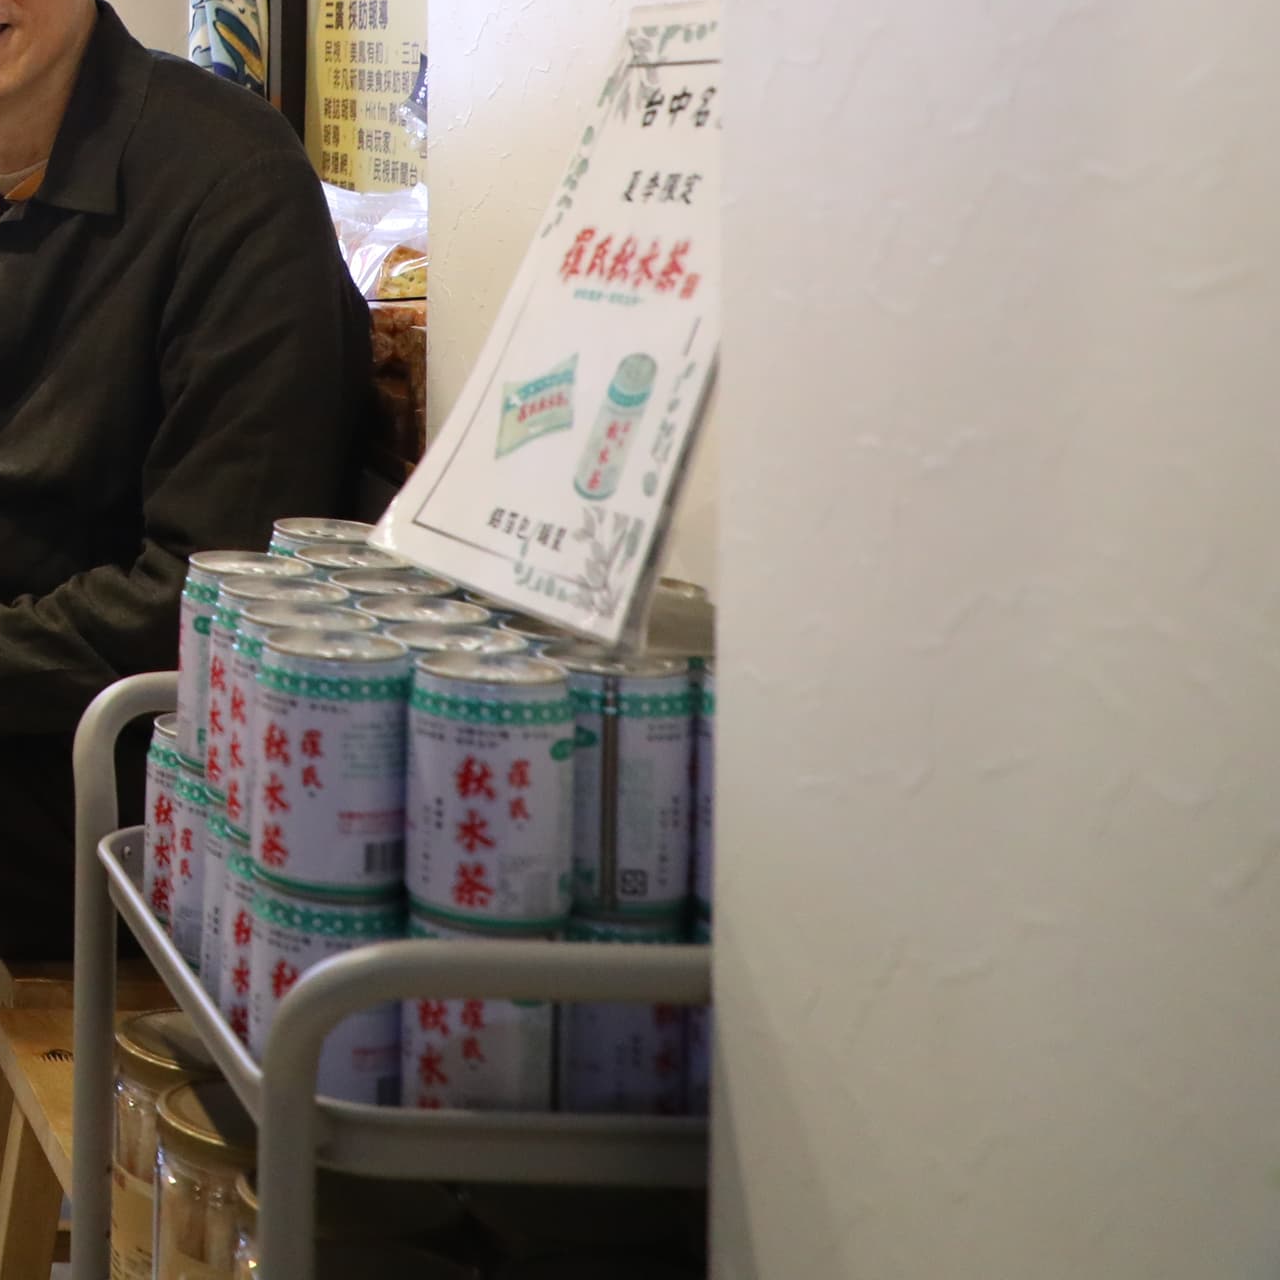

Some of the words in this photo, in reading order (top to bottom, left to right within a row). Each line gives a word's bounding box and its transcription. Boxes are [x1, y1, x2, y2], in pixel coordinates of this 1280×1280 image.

[641, 85, 724, 130] 台中名
[301, 728, 324, 791] 羅氏
[508, 758, 531, 821] 羅氏
[261, 722, 291, 869] 秋水茶
[453, 753, 496, 908] 秋水茶
